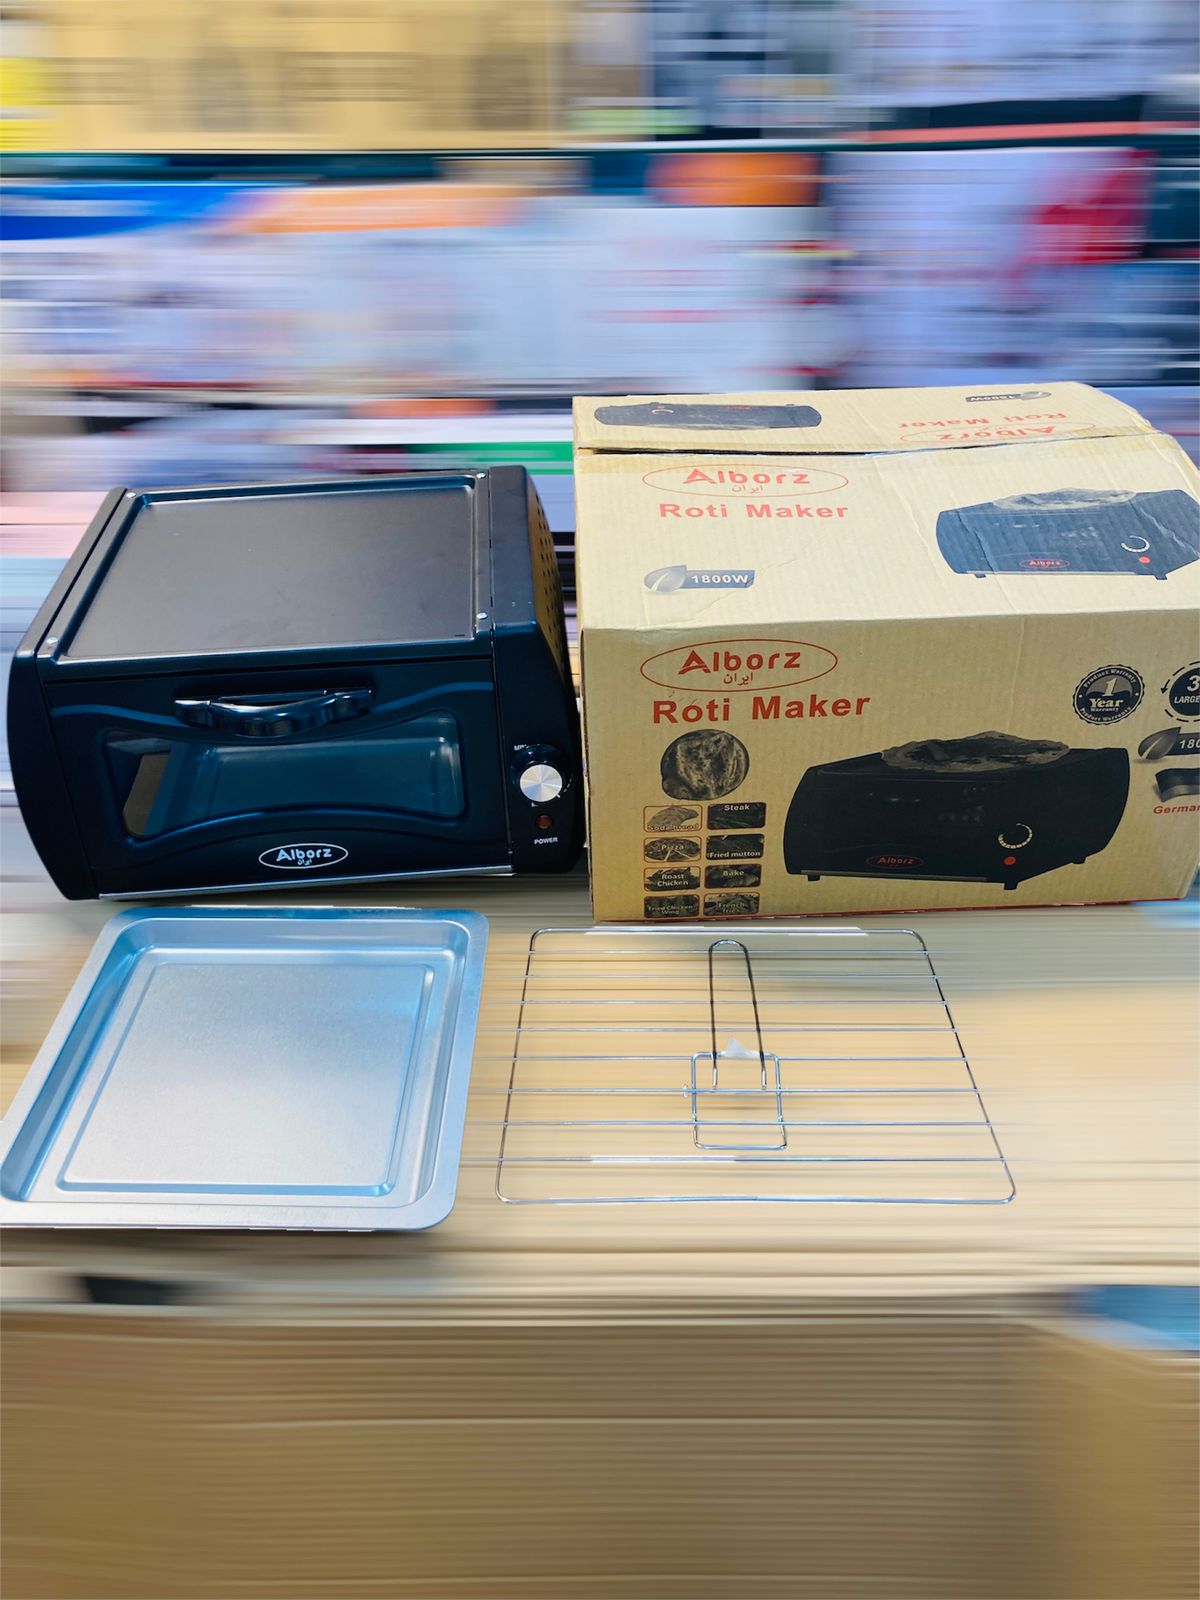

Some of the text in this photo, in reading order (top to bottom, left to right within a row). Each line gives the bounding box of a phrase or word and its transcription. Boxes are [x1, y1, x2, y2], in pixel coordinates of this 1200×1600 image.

[939, 426, 1056, 440] Alborz
[682, 468, 811, 485] Alborz
[659, 503, 848, 518] Roti Maker
[691, 574, 749, 584] 1800W
[678, 650, 801, 675] Alborz
[723, 672, 754, 686] ایران
[1102, 678, 1117, 697] 1
[653, 694, 870, 724] Roti Maker
[1089, 698, 1124, 708] Year
[534, 837, 558, 845] POWER
[276, 848, 332, 862] Alborz
[709, 851, 729, 859] Fried
